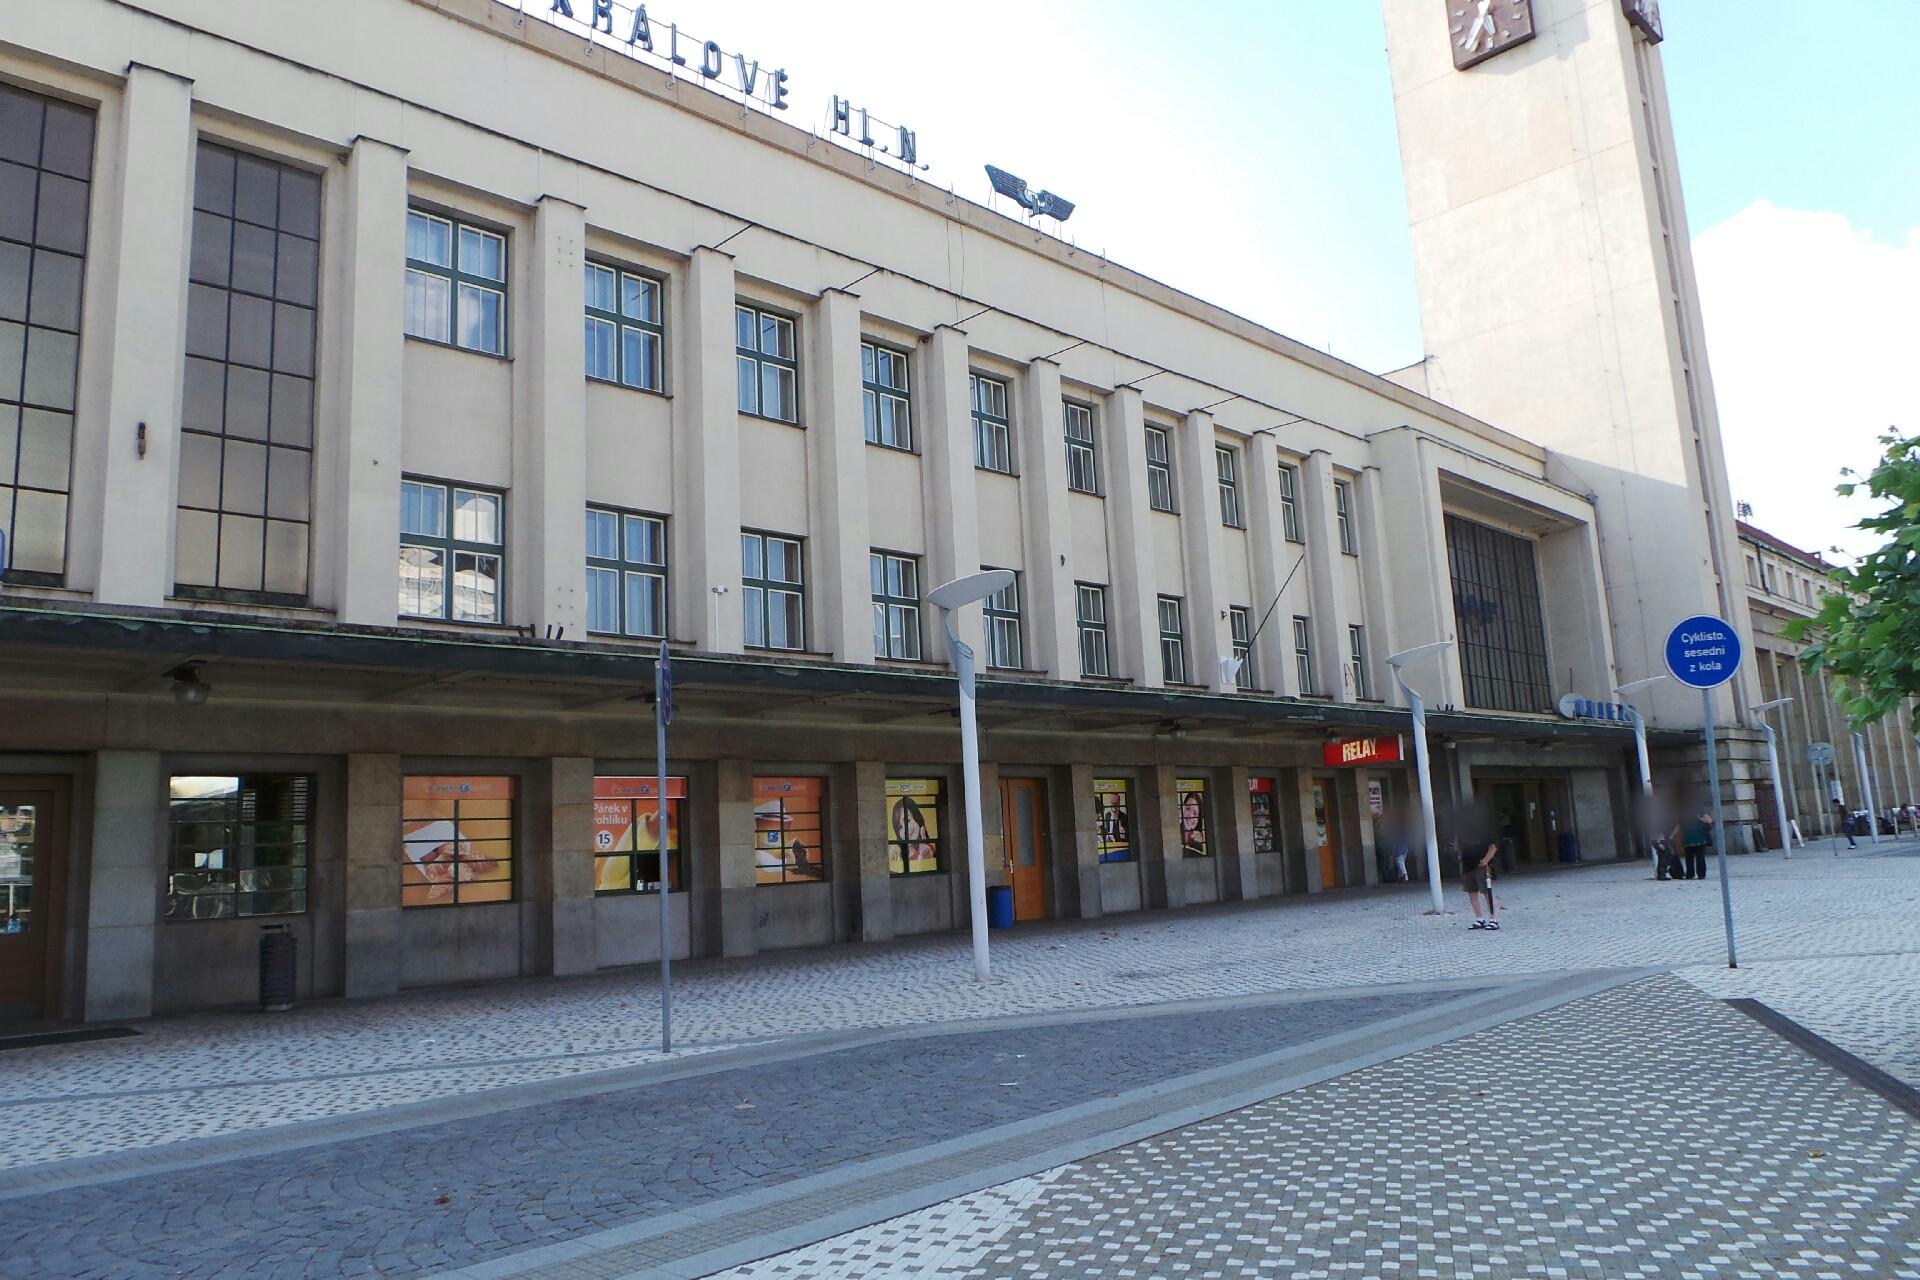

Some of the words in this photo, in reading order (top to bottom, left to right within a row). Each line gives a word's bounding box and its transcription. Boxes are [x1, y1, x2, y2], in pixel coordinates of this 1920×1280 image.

[1684, 645, 1725, 657] sesedni
[1689, 664, 1697, 672] z
[1699, 661, 1722, 671] kola
[1342, 738, 1377, 762] RELAY
[598, 833, 610, 844] 15
